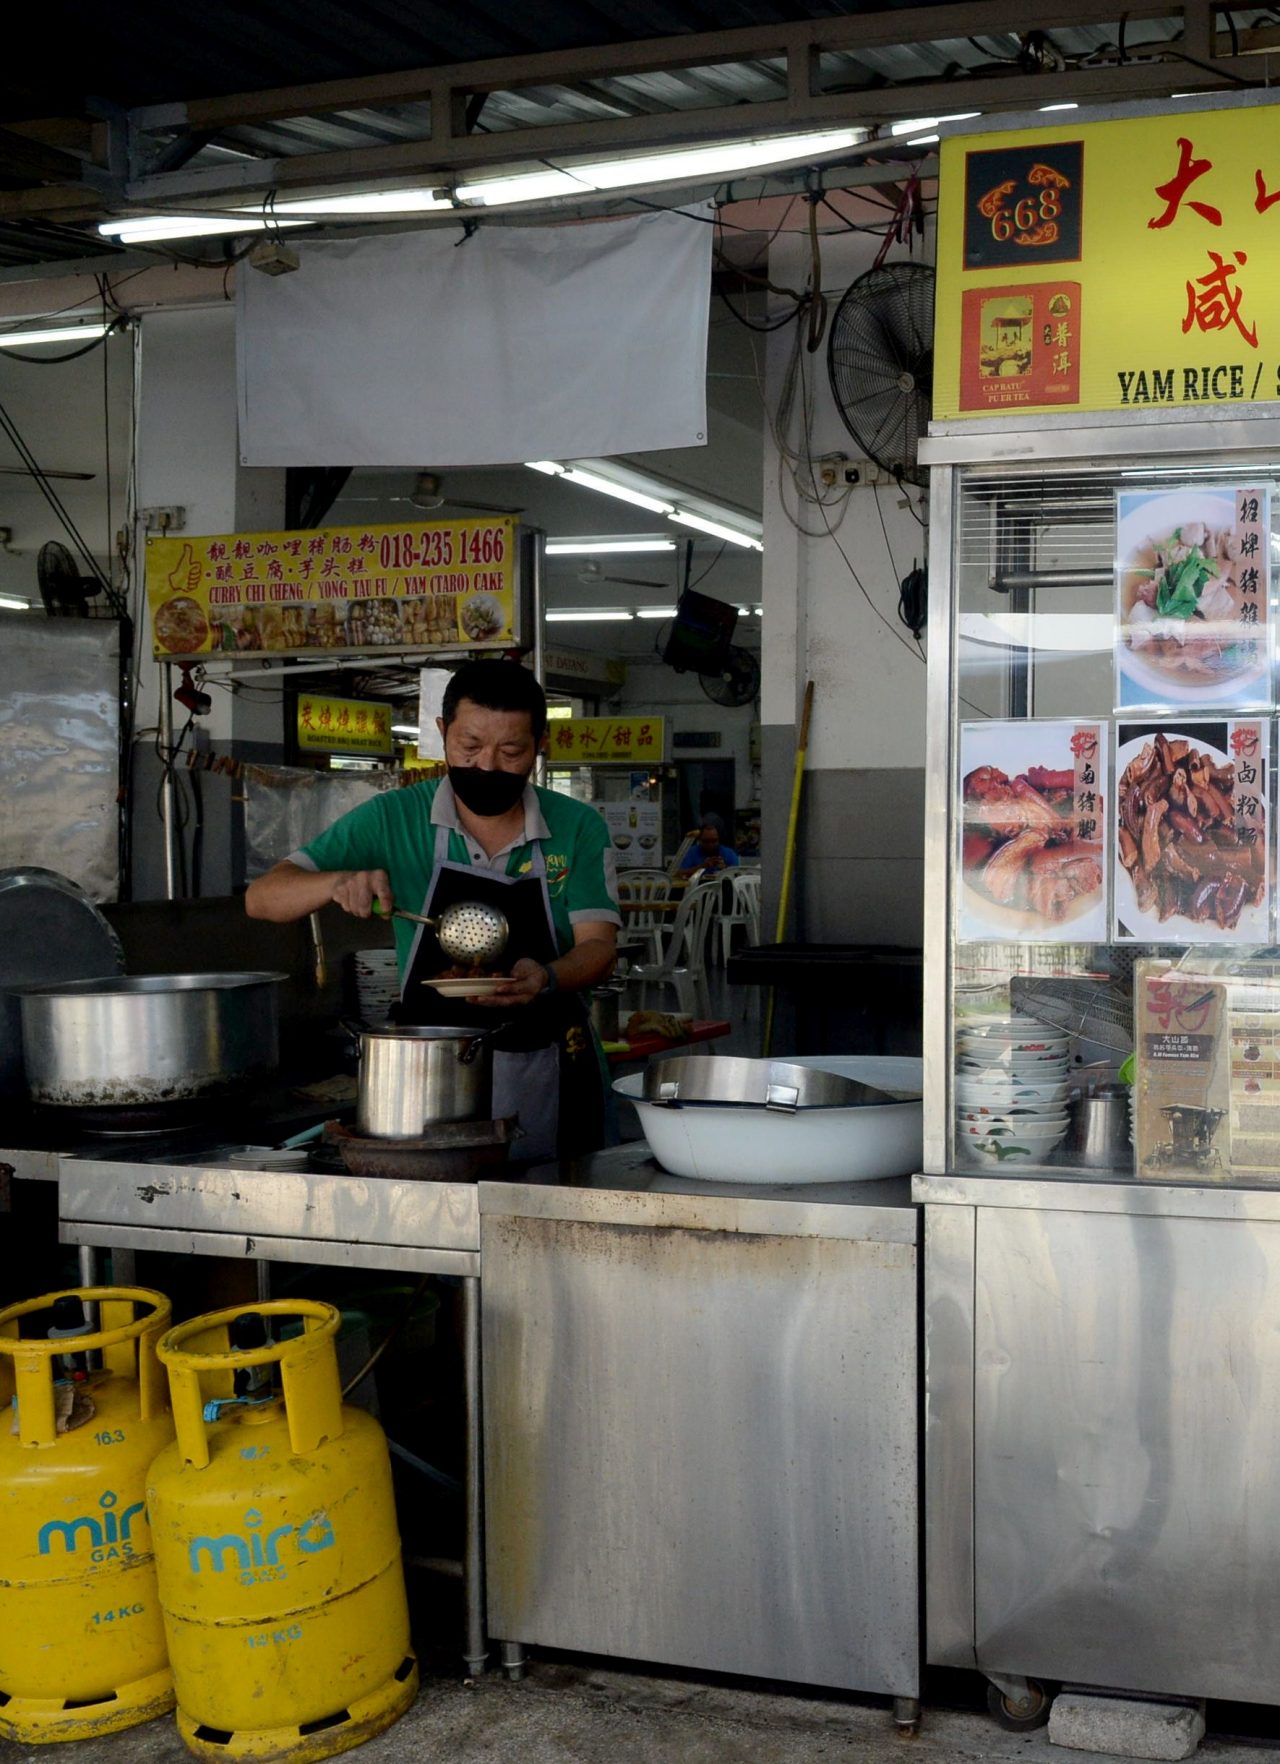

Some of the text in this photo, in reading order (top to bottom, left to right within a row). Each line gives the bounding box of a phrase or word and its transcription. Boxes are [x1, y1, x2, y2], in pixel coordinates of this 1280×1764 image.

[991, 187, 1062, 242] 668
[1118, 368, 1174, 404] YAM
[1181, 364, 1244, 400] RICE
[1250, 361, 1264, 399] /
[380, 527, 504, 569] 018-235 1466
[209, 585, 241, 604] CURRY
[246, 584, 266, 603] CHI
[269, 582, 304, 601] CHENG
[318, 580, 348, 599] YONG
[352, 578, 373, 598] TAU
[375, 577, 388, 596] FU
[404, 575, 427, 595] YAM
[430, 573, 469, 594] (TARO)
[474, 571, 504, 592] CAKE
[93, 1428, 126, 1447] 16.3
[38, 1490, 151, 1556] mir
[189, 1507, 336, 1574] mira
[90, 1540, 135, 1564] GAS
